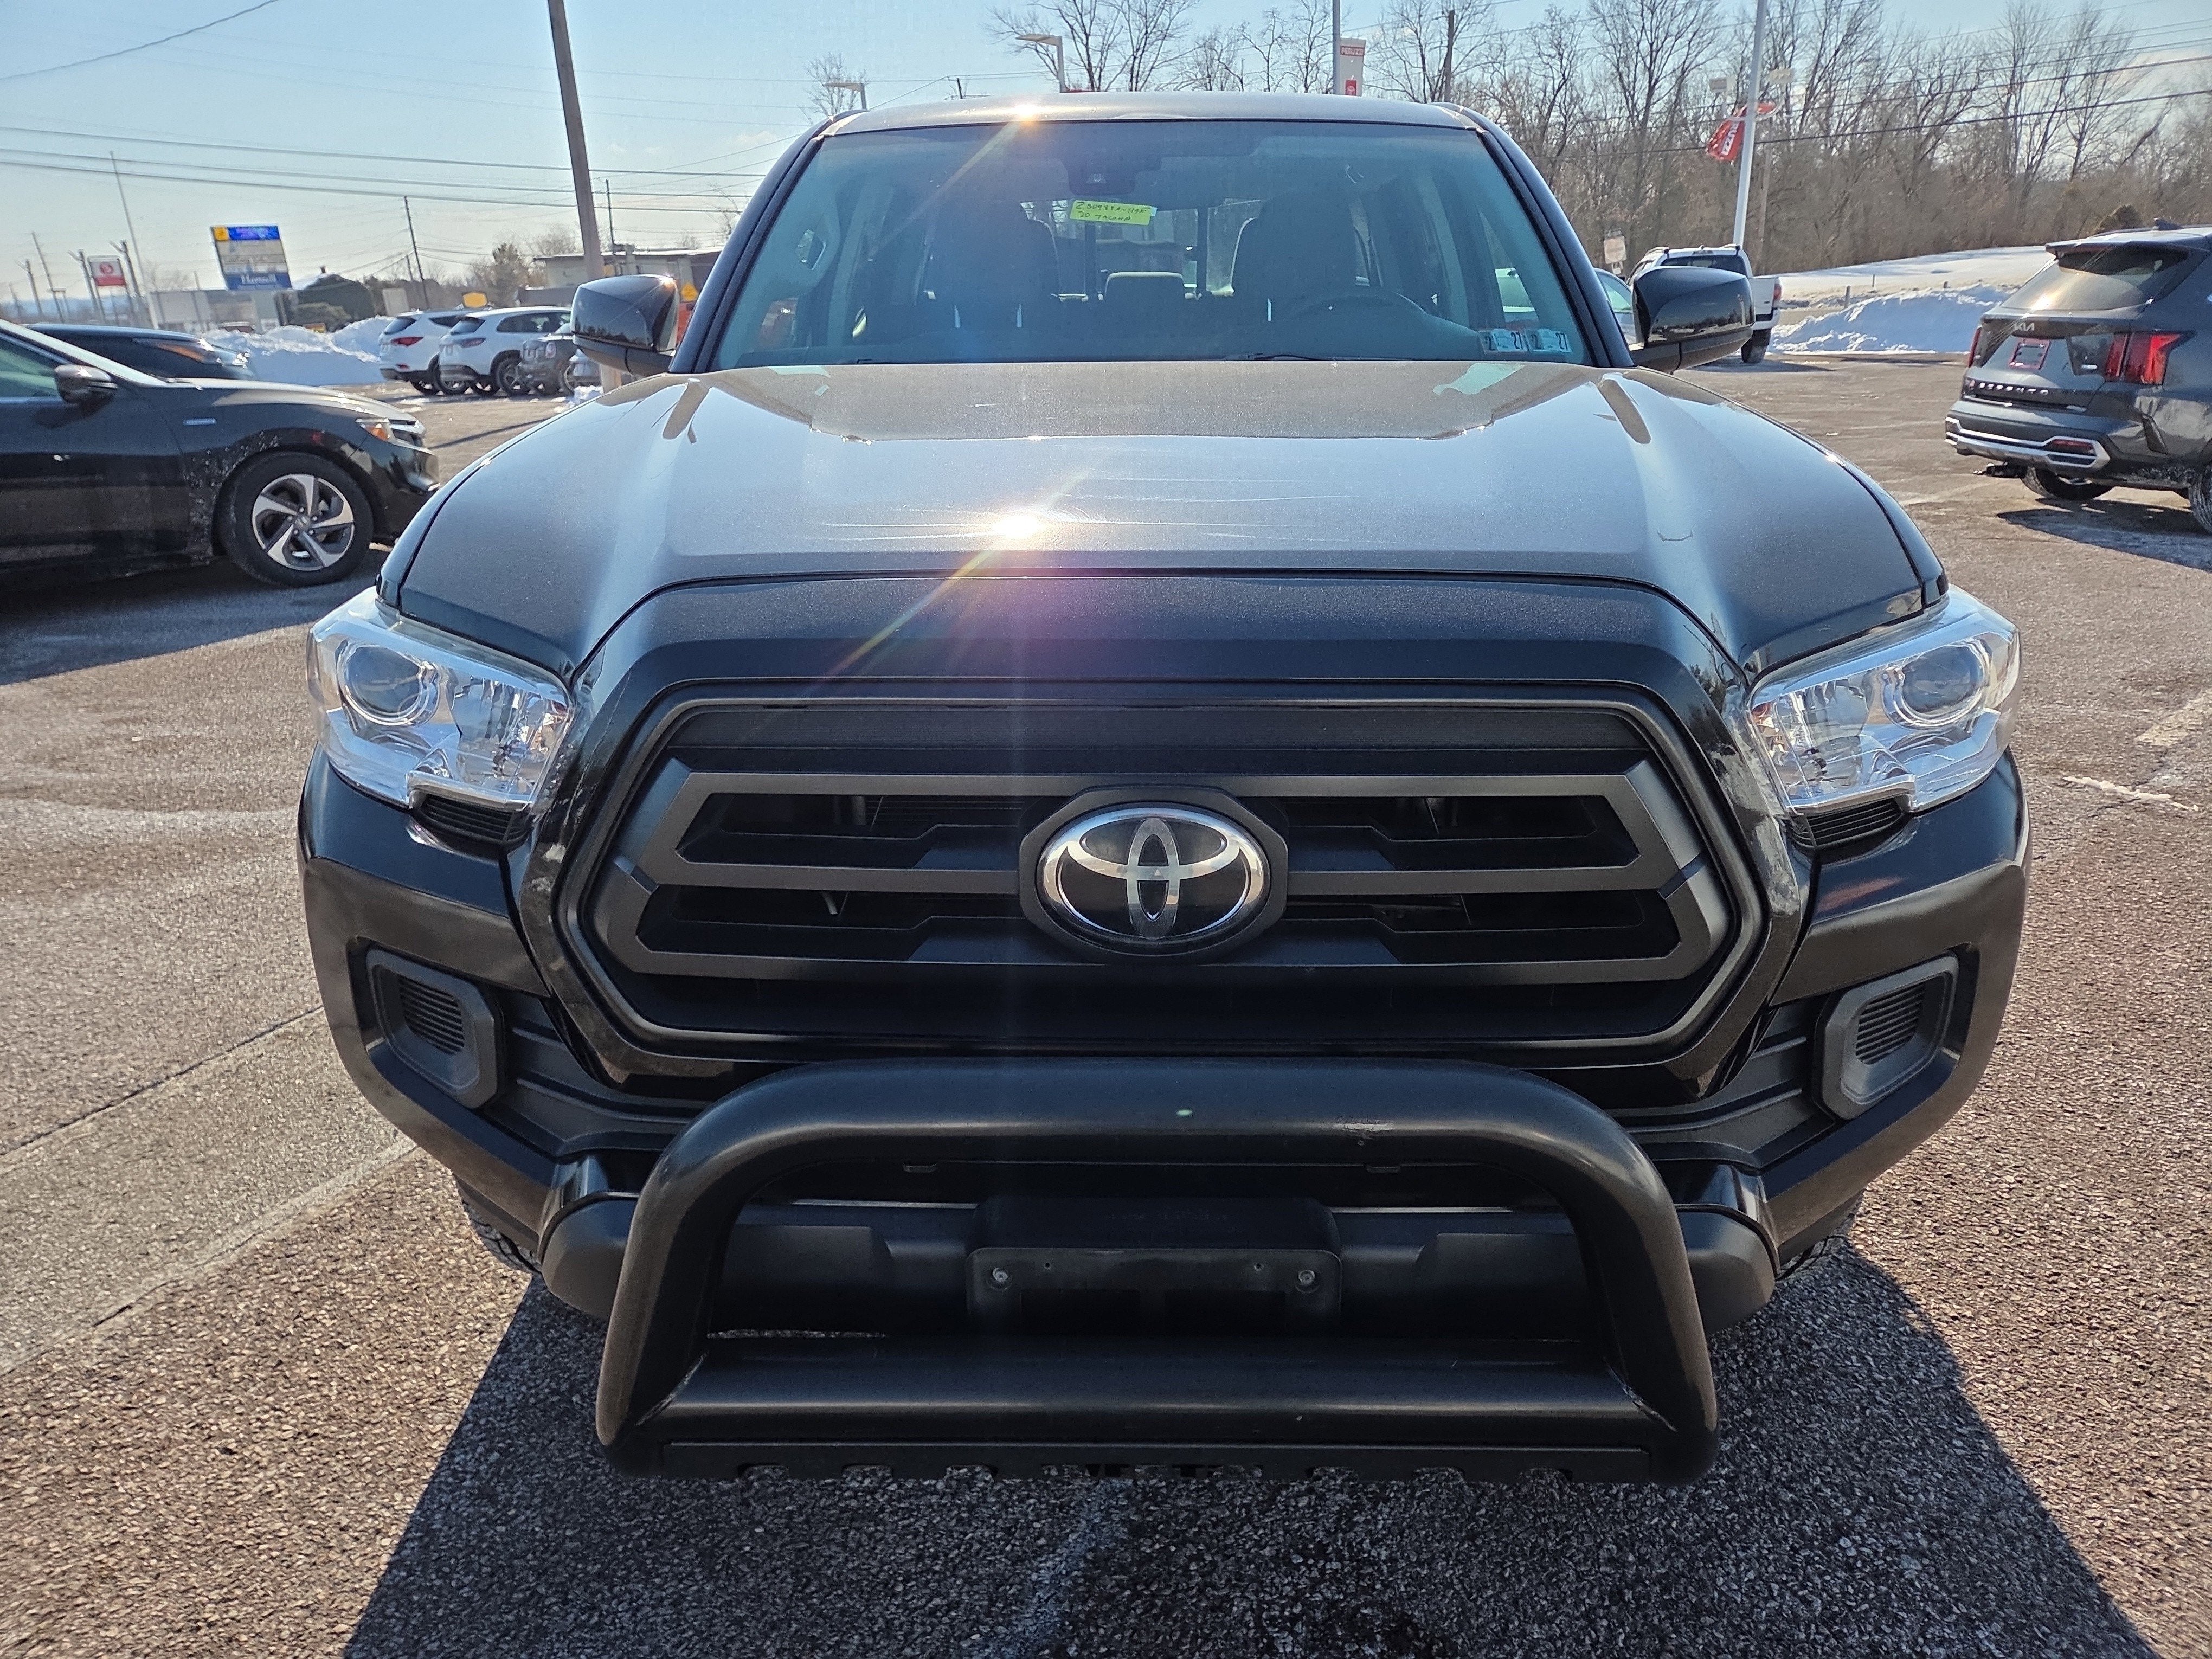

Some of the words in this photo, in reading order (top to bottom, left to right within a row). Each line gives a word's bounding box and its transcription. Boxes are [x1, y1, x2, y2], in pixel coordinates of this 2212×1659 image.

[1341, 47, 1364, 55] PERUZZI
[1510, 332, 1523, 351] 27
[1555, 332, 1568, 350] 27
